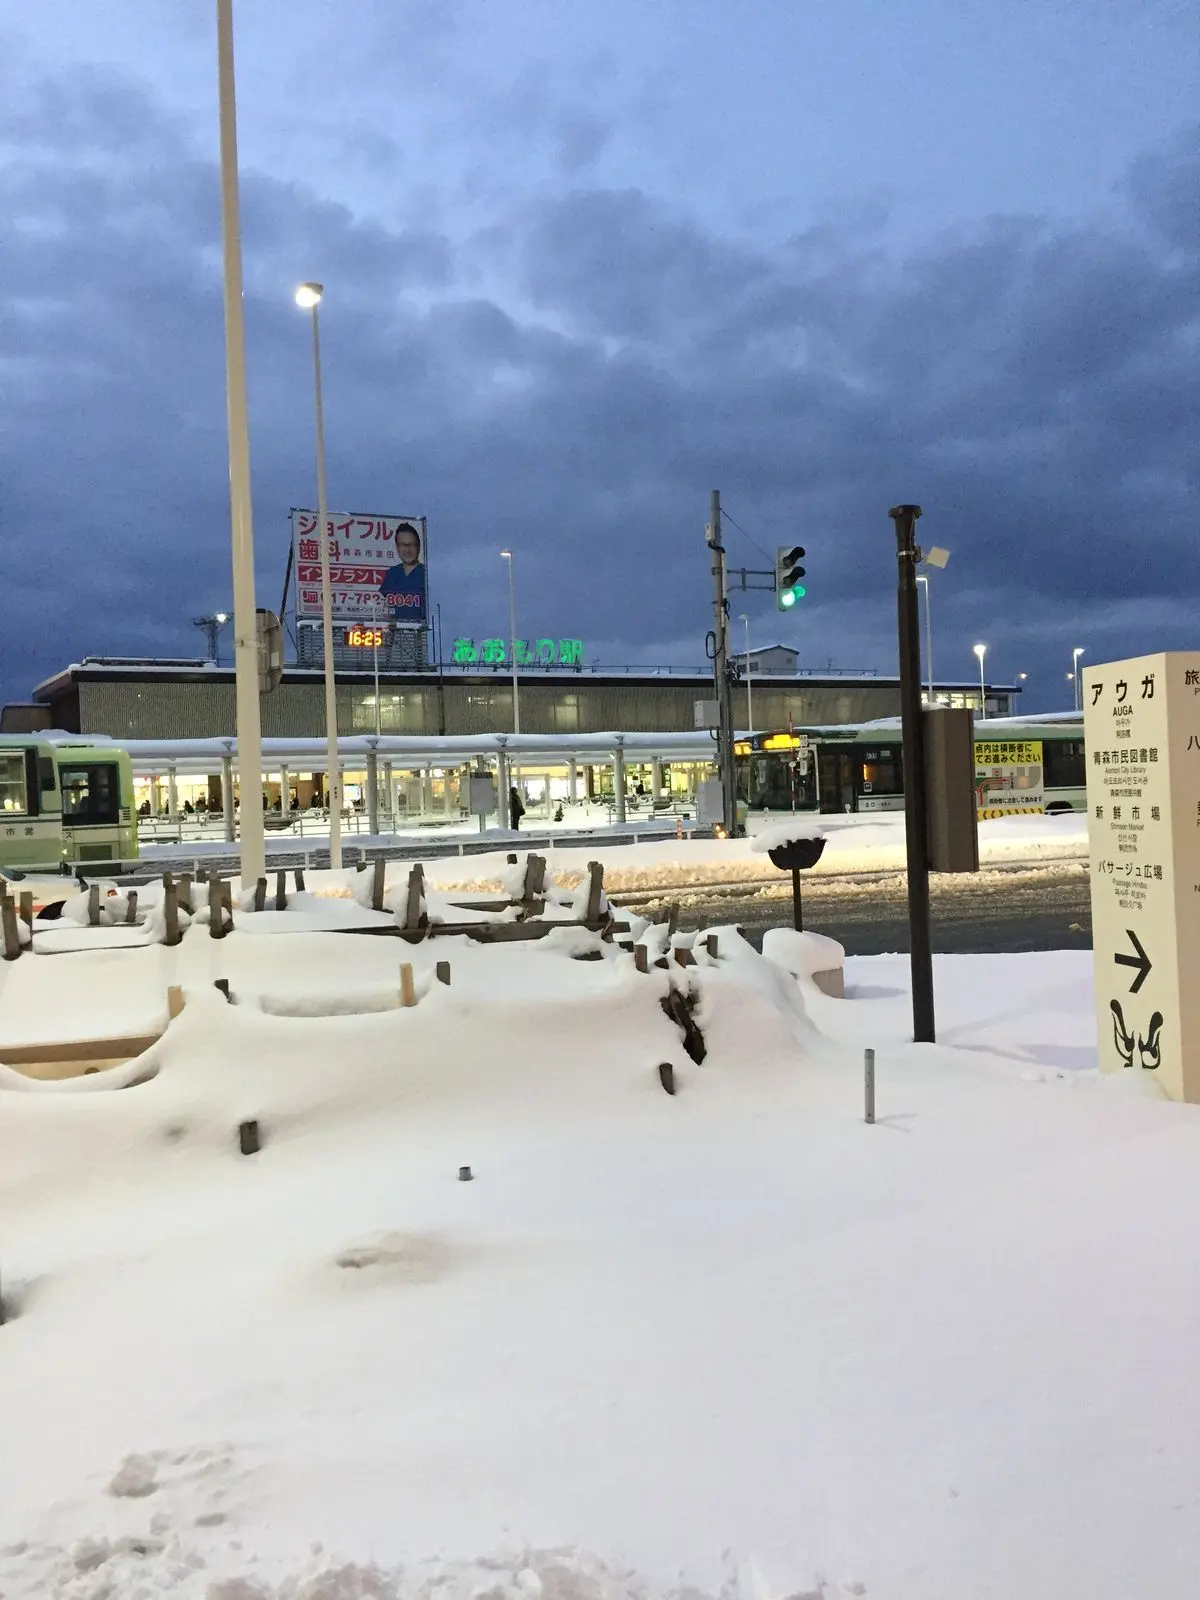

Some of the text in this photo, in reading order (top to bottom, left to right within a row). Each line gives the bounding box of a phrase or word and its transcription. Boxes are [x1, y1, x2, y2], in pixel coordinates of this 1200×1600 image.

[298, 515, 394, 541] ジョイフル
[454, 639, 582, 663] あおもり駅
[1091, 673, 1155, 706] アウガ
[1112, 704, 1134, 717] AUGA
[1093, 747, 1158, 766] 青森市民図書館
[1095, 805, 1160, 821] 新鮮市場
[6, 827, 34, 836] 市営
[1098, 859, 1163, 881] パサージュ広場
